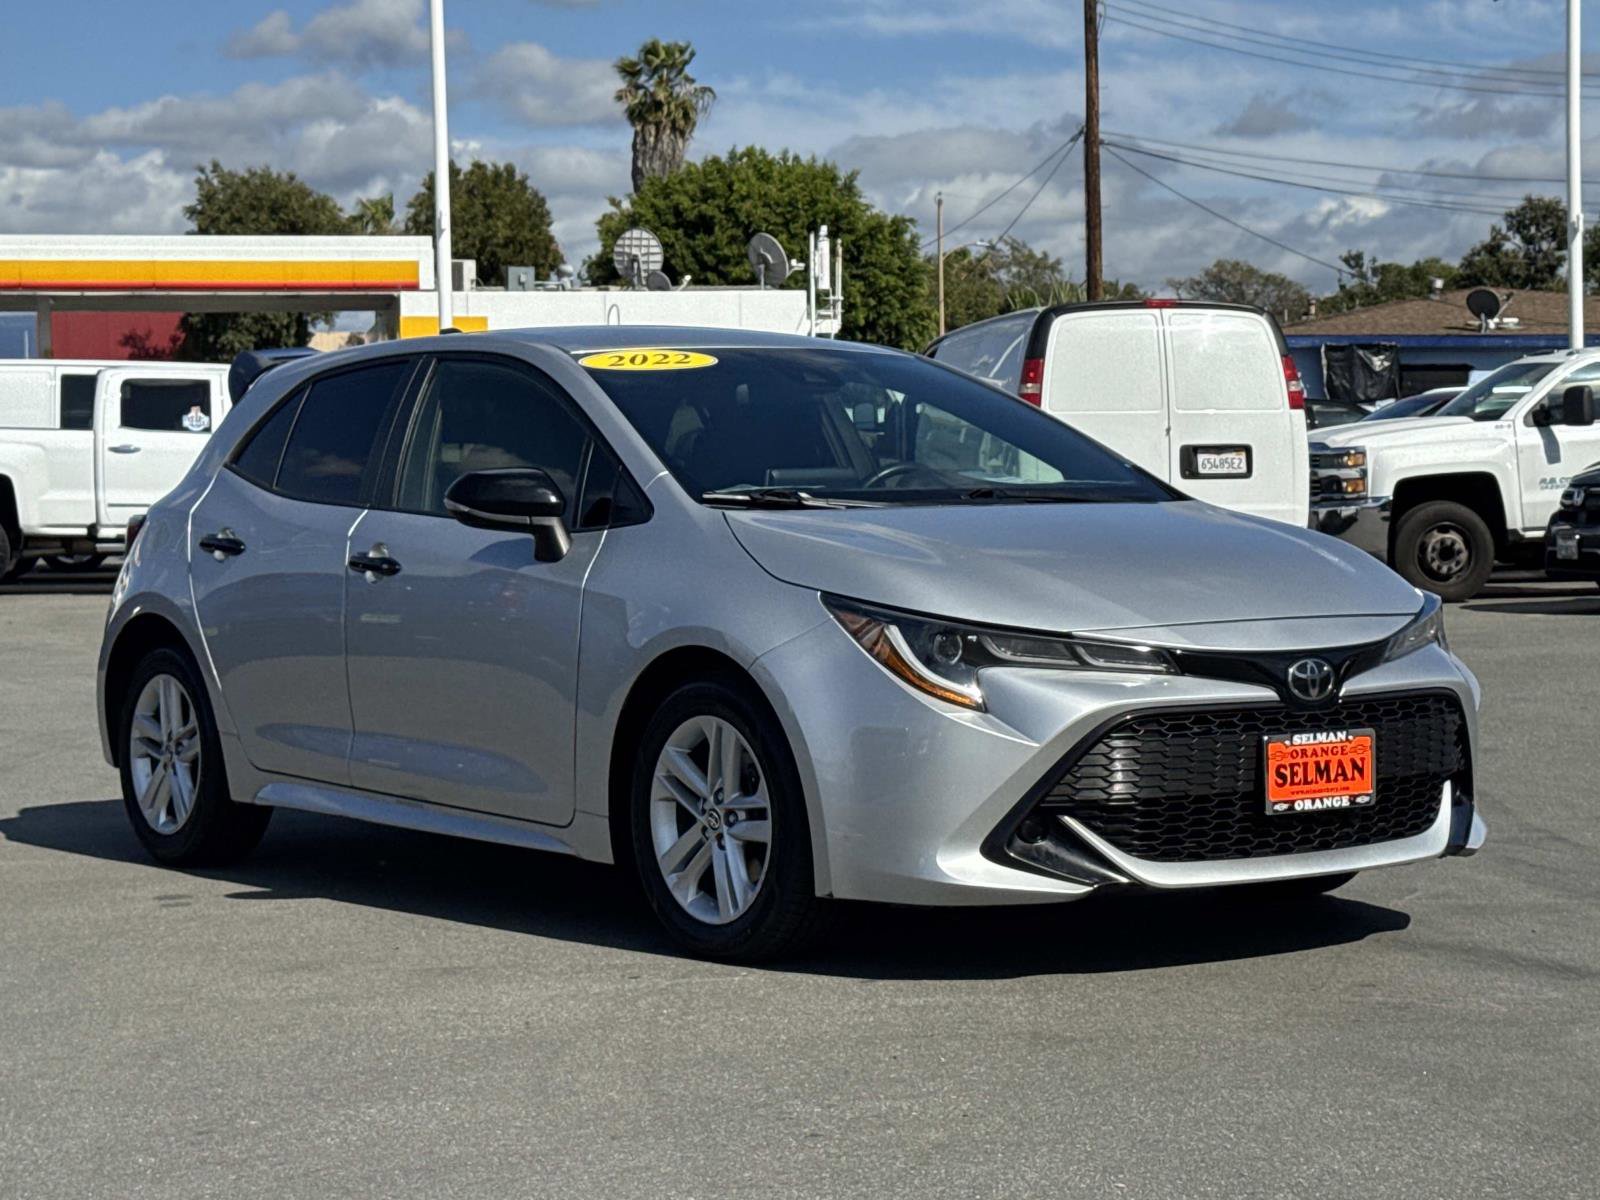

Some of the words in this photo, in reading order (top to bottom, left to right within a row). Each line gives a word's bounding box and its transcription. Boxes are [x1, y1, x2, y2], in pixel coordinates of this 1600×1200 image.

[608, 354, 690, 367] 2022
[1292, 731, 1347, 745] SELMAN
[1290, 745, 1349, 759] ORANGE
[1275, 757, 1366, 788] SELMAN
[1294, 796, 1350, 811] ORANGE
